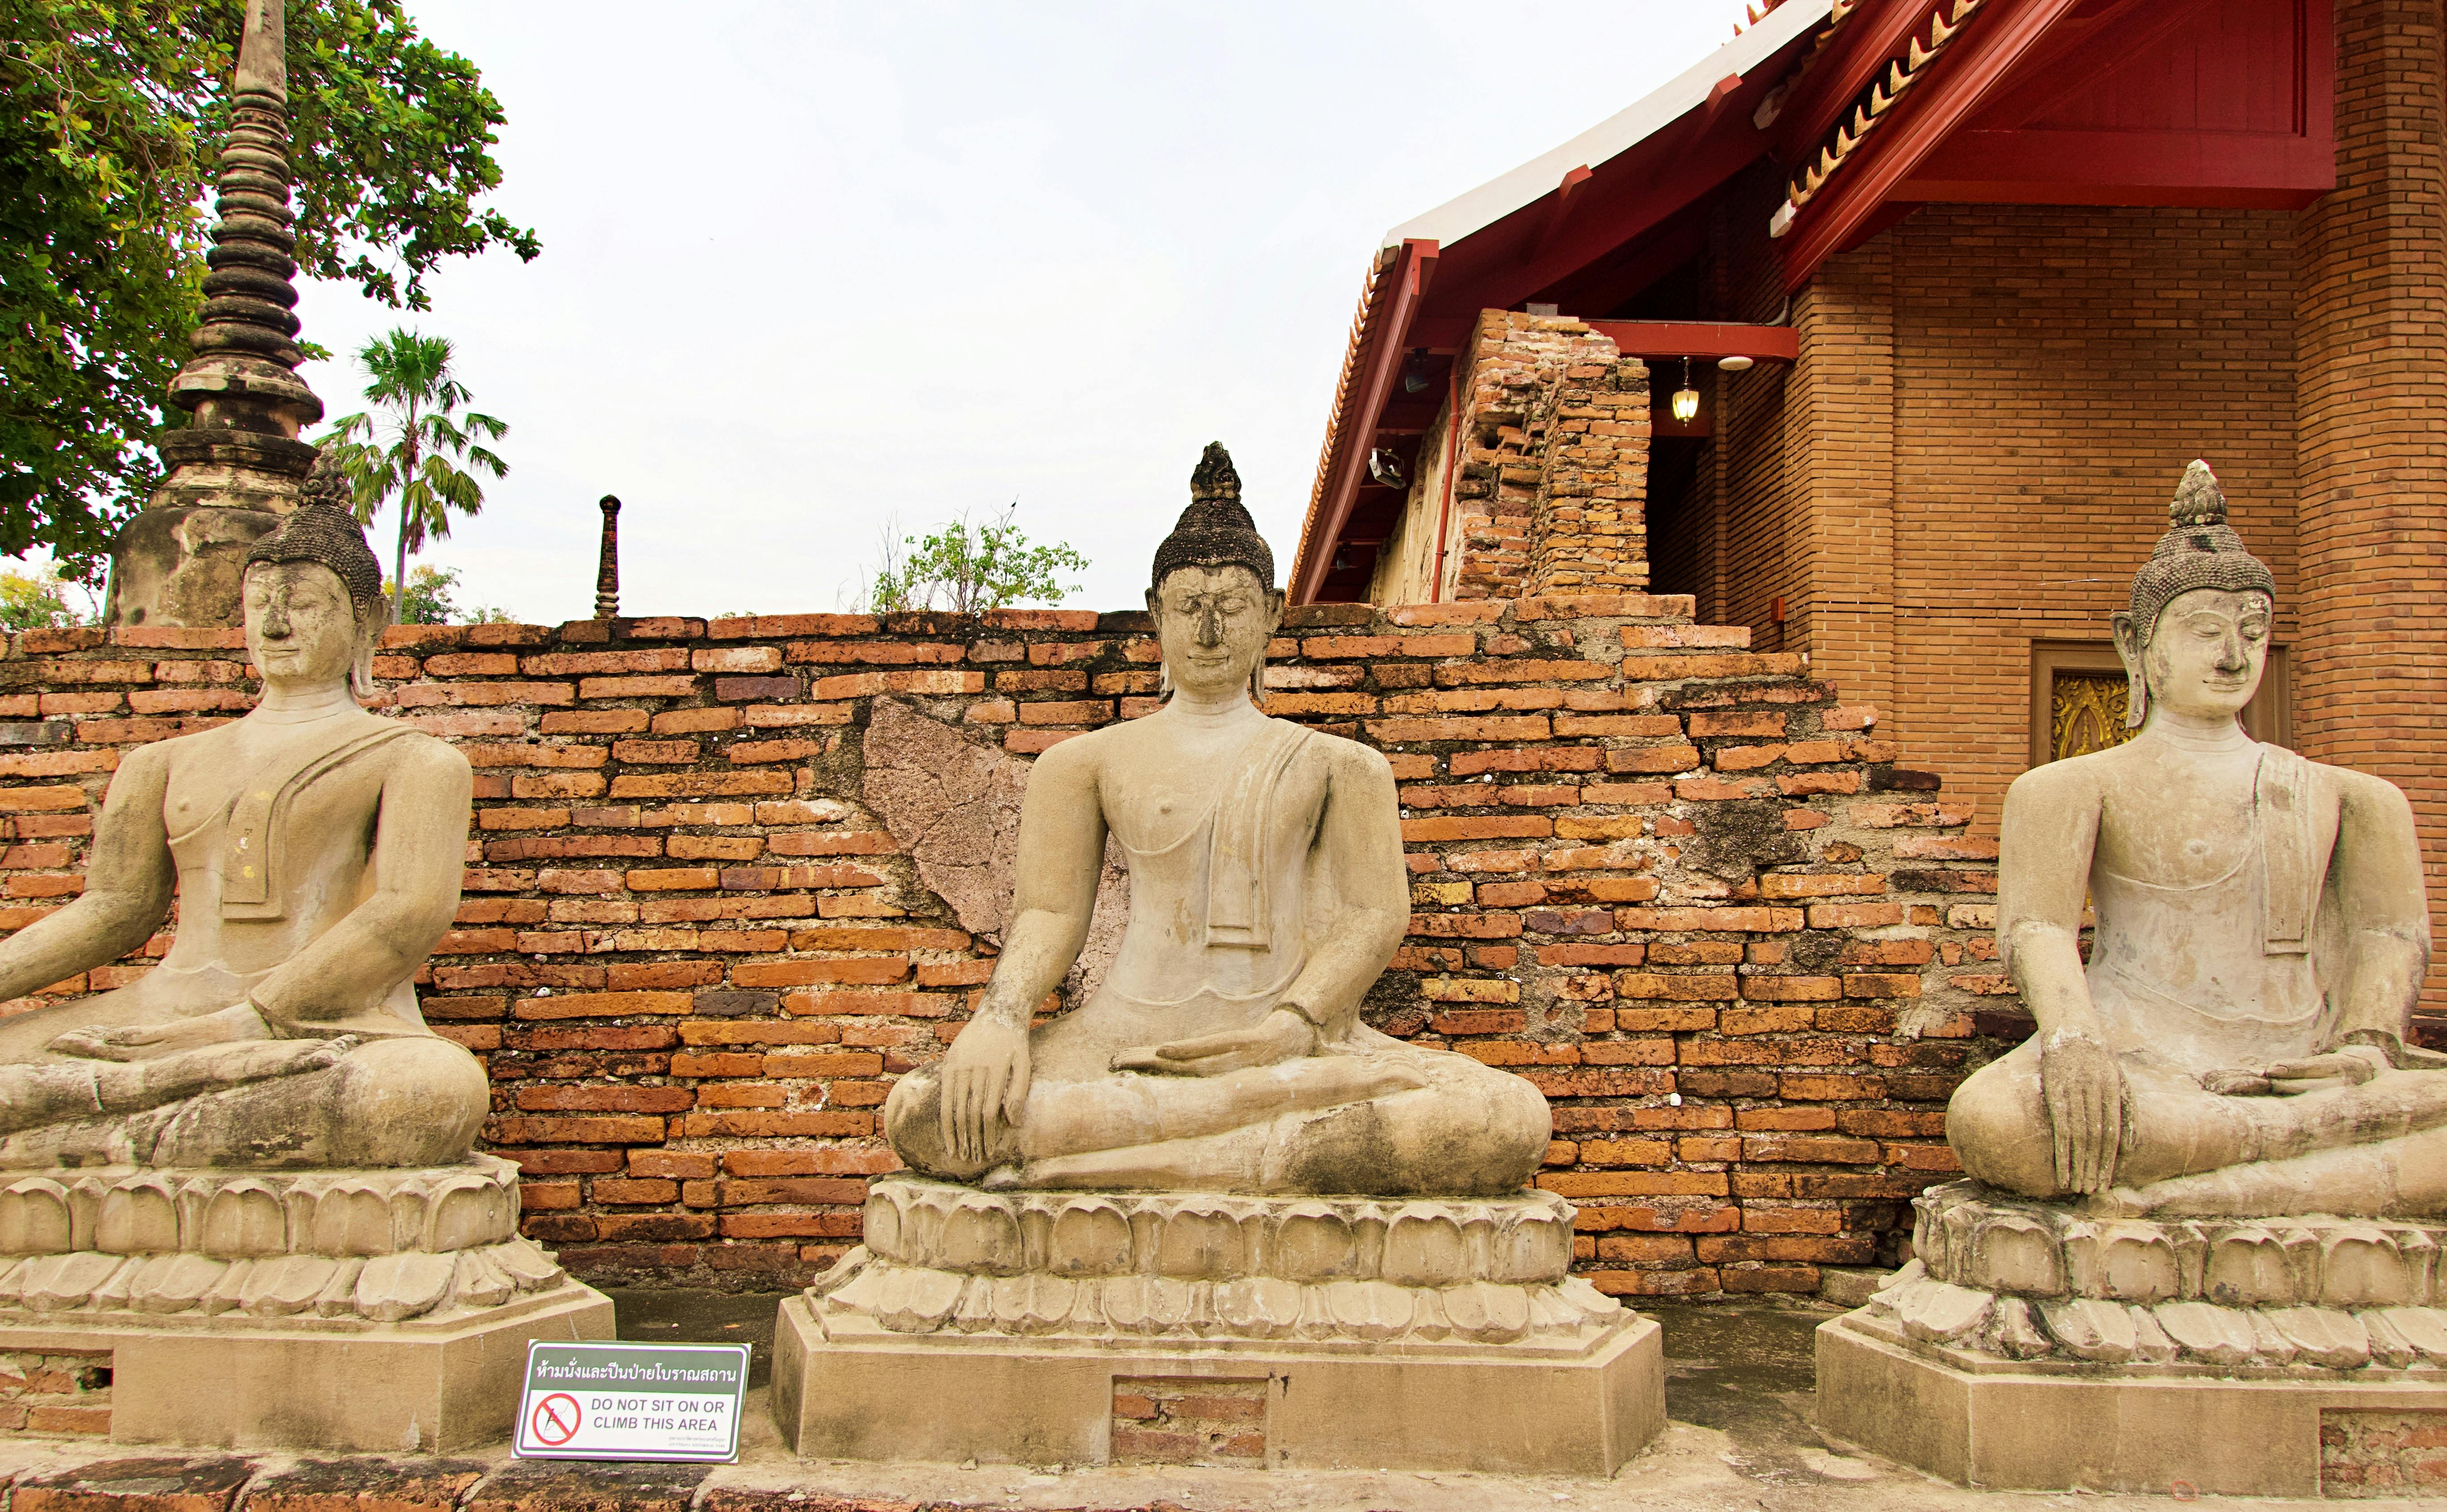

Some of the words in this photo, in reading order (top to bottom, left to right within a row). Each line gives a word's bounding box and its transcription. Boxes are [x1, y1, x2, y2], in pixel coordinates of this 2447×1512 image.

[536, 1357, 737, 1382] ห้ามนั่งและปีนป่ายโบราณสถาน
[592, 1398, 613, 1410] DO
[617, 1399, 647, 1411] NOT
[652, 1400, 674, 1411] SIT
[678, 1401, 699, 1412] ON
[703, 1402, 724, 1413] OR
[594, 1417, 637, 1429] CLIMB
[643, 1418, 674, 1430] THIS
[678, 1419, 717, 1431] AREA
